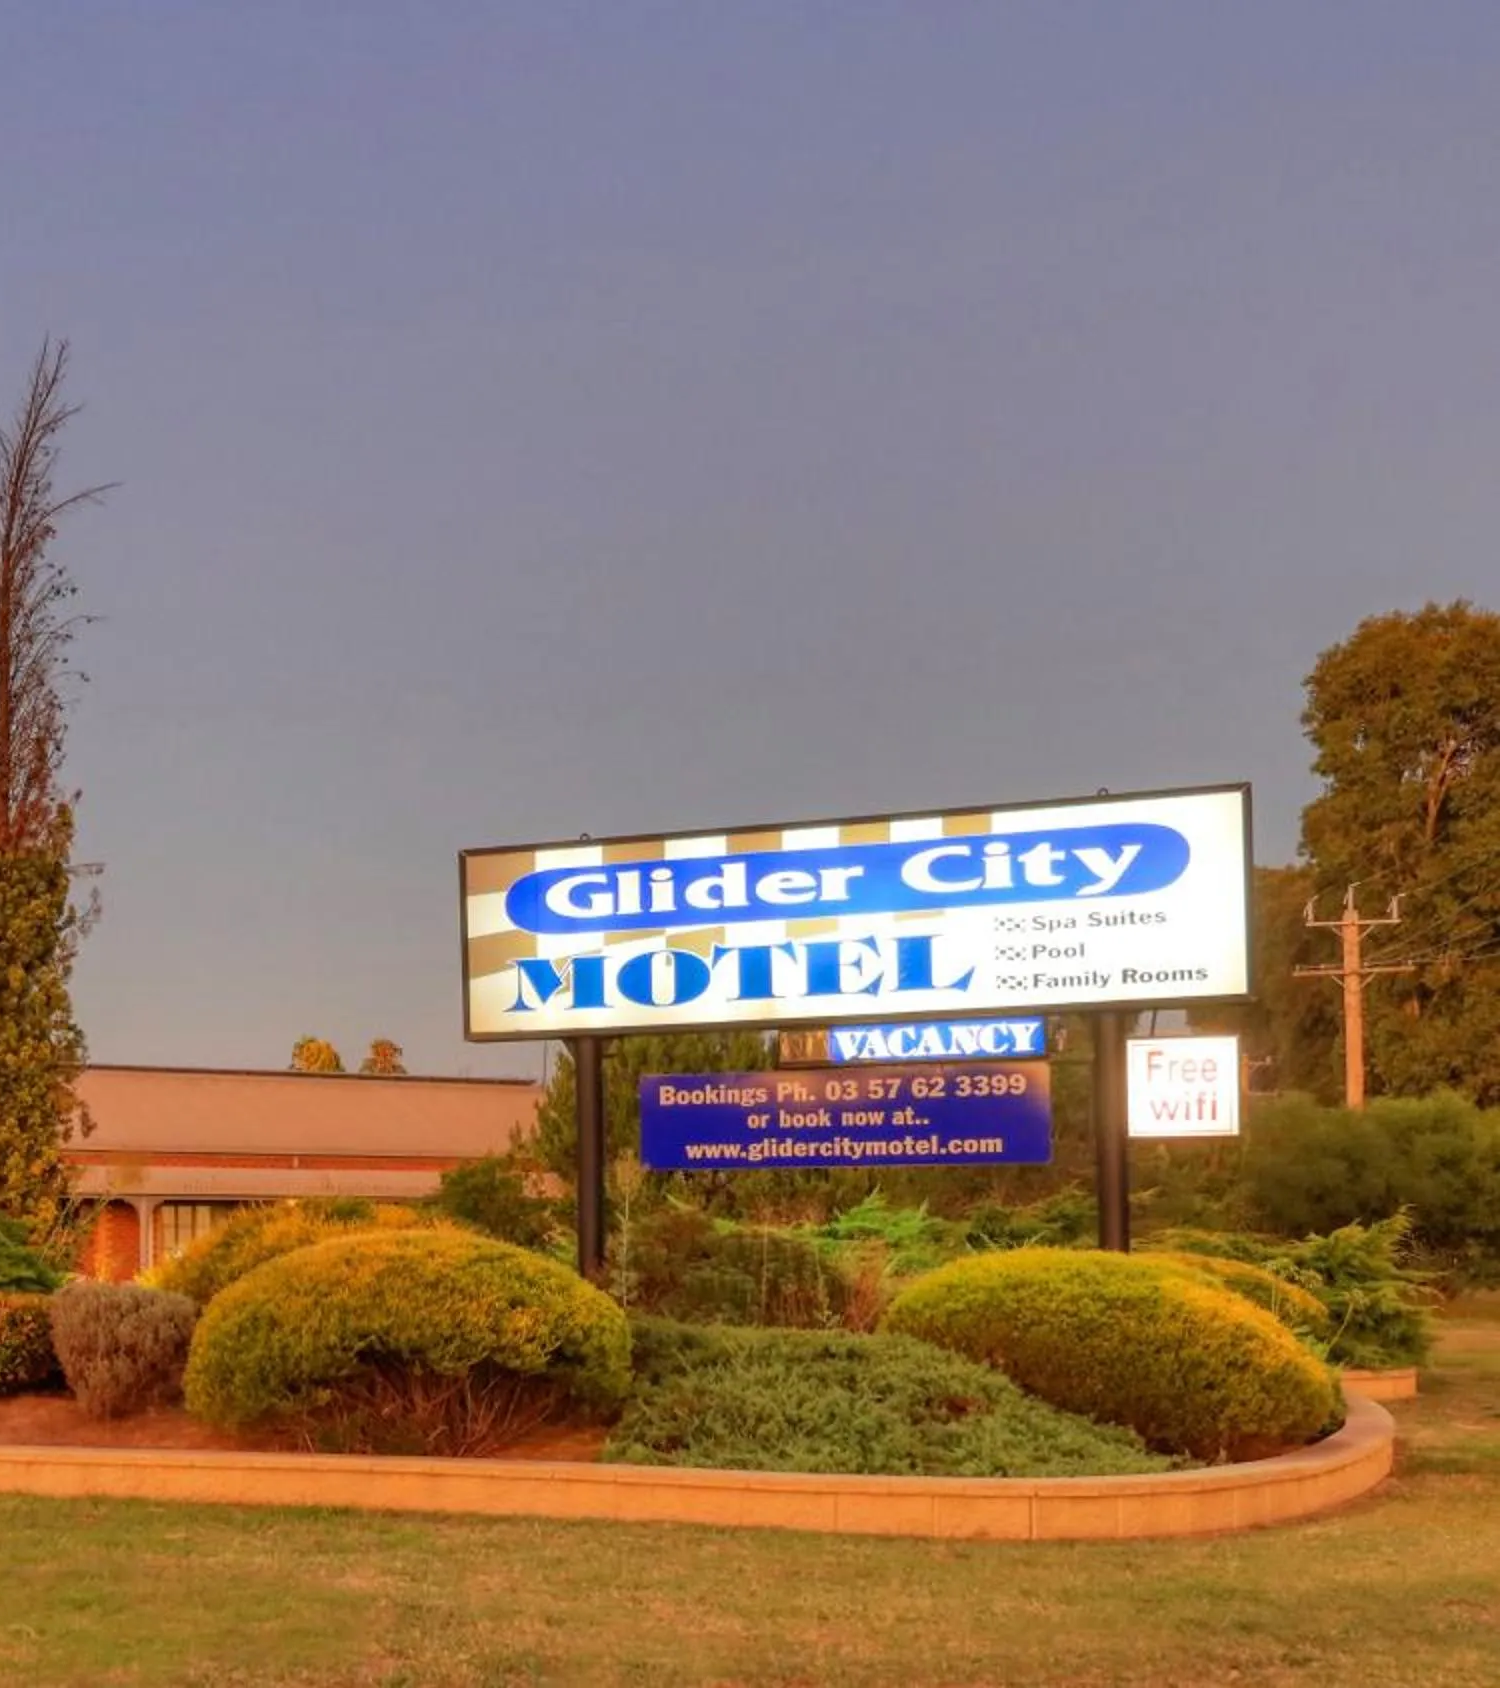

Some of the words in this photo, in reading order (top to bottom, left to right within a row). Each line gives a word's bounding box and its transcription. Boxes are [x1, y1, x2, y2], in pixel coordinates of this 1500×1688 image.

[545, 864, 864, 919] Glider
[901, 839, 1143, 895] City
[1031, 915, 1077, 933] Spa
[1087, 910, 1168, 928] Suites
[1031, 942, 1085, 960] Pool
[504, 934, 976, 1012] MOTEL
[1032, 971, 1111, 989] Family
[1121, 966, 1209, 985] Rooms
[833, 1022, 1040, 1058] VACANCY
[1146, 1050, 1217, 1082] Free
[659, 1084, 767, 1107] Bookings
[776, 1084, 815, 1102] Ph.
[825, 1081, 858, 1101] 03
[867, 1079, 899, 1099] 57
[911, 1077, 945, 1098] 62
[954, 1074, 1027, 1096] 3399
[747, 1113, 770, 1128] or
[779, 1108, 831, 1127] book
[841, 1110, 884, 1126] now
[1149, 1091, 1217, 1120] wifi
[686, 1136, 1003, 1161] www.glidercitymotel.com
